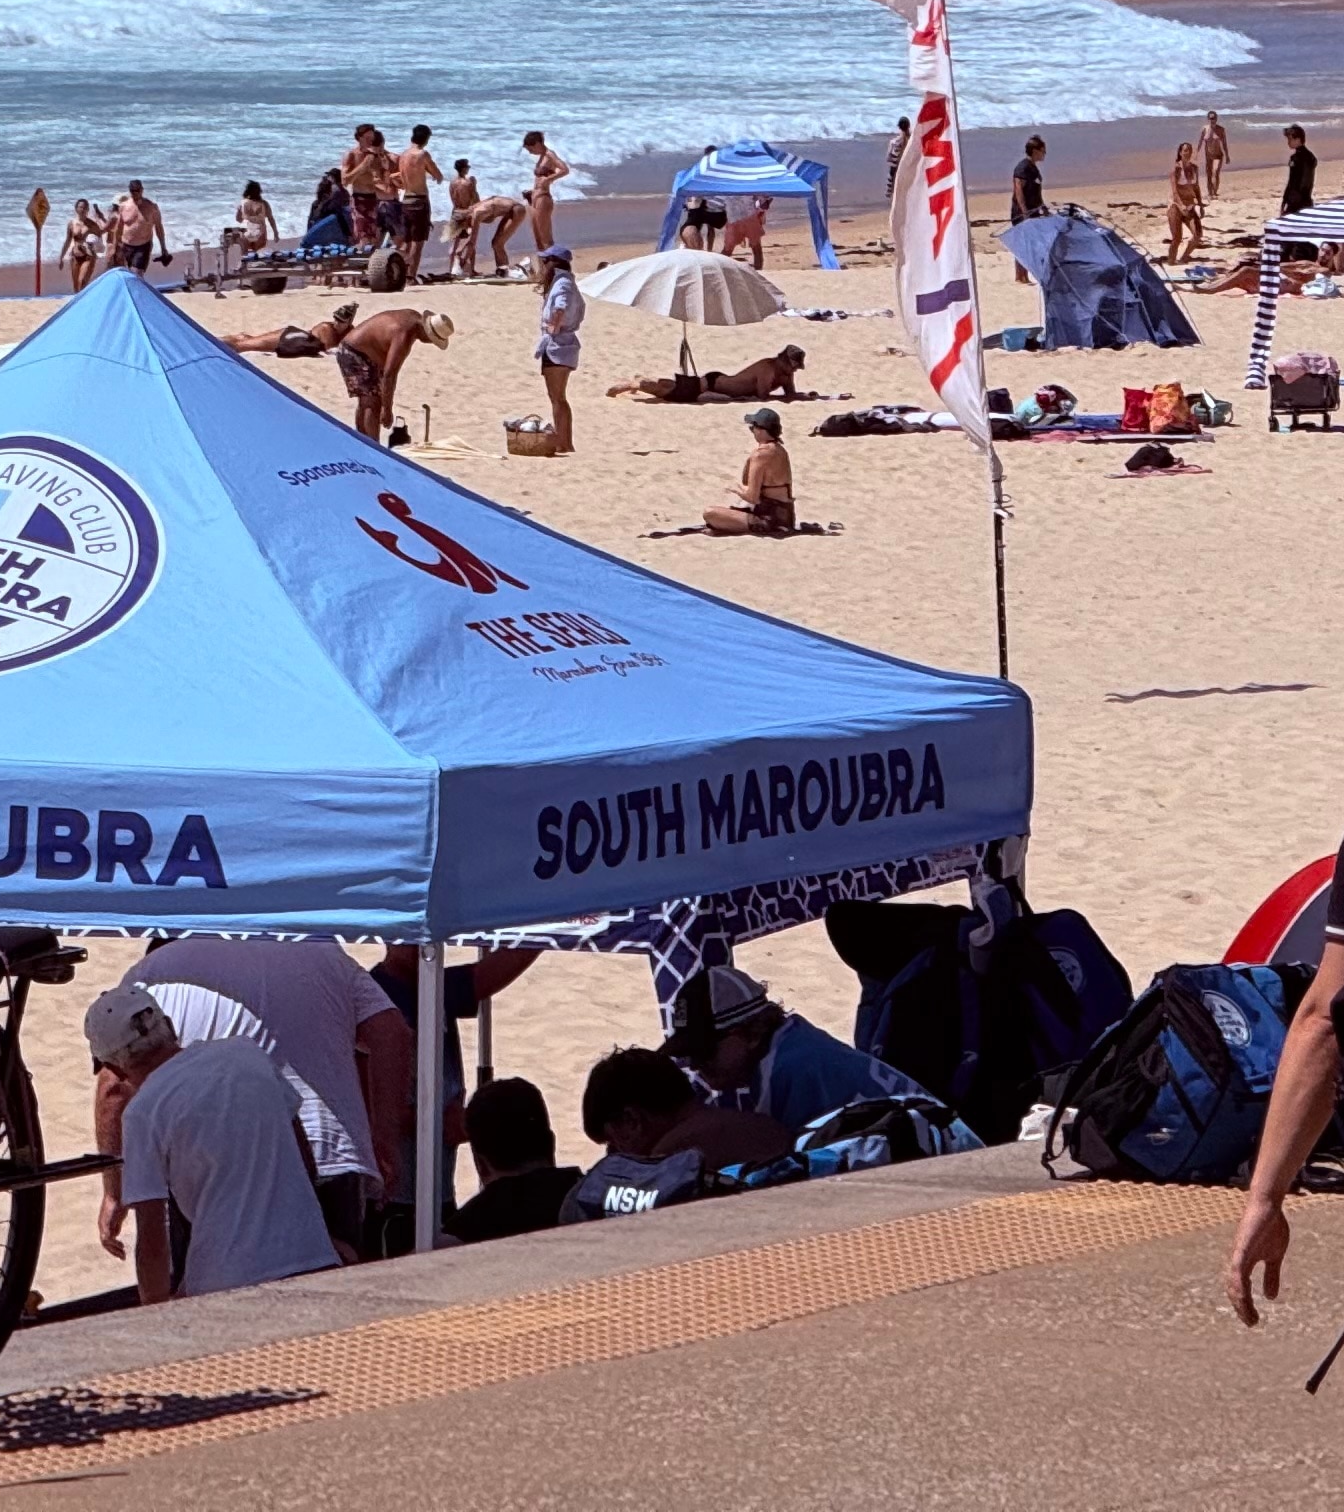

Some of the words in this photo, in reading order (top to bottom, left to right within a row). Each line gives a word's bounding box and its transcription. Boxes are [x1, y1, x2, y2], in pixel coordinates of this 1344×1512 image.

[69, 493, 117, 555] CLUB
[465, 617, 557, 659] THE
[521, 611, 632, 649] SEALS
[533, 783, 686, 880] SOUTH
[698, 743, 945, 850] MAROUBRA
[604, 1186, 659, 1213] NSW
